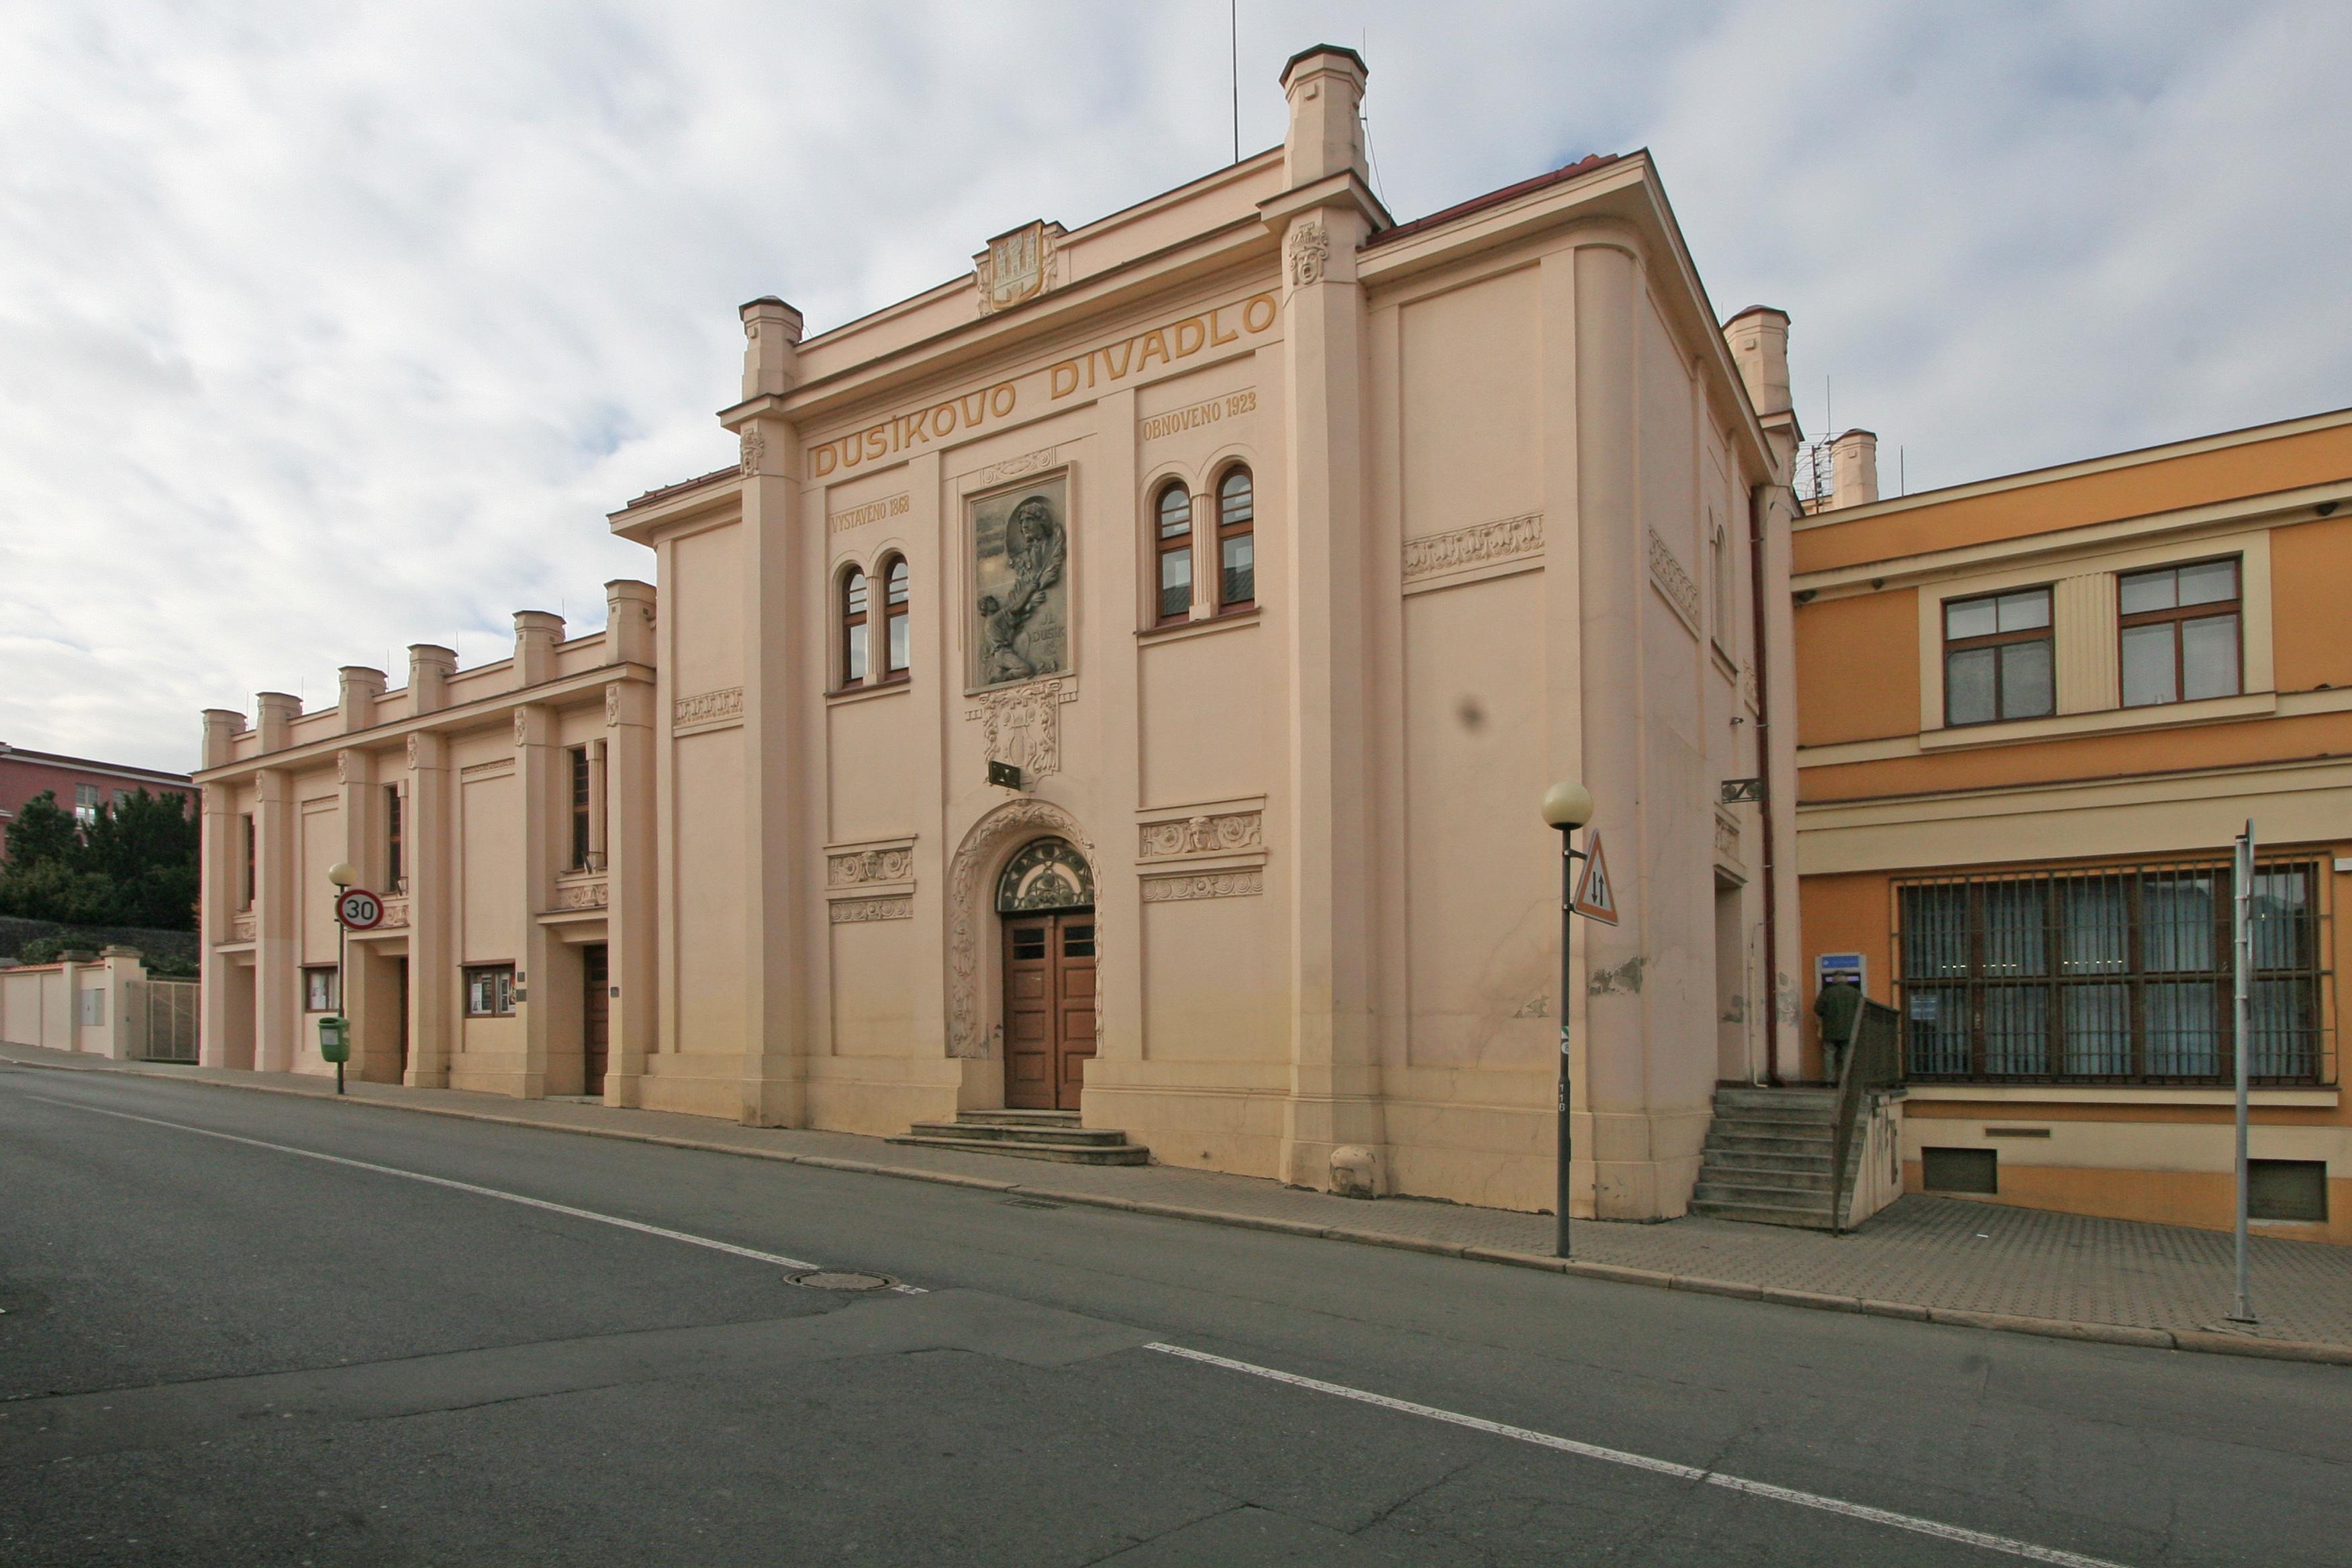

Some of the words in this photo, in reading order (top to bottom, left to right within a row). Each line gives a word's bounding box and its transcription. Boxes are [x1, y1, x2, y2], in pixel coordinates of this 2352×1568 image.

[1050, 293, 1276, 401] DIVADLO
[1143, 402, 1221, 441] OBNOVENO
[1226, 391, 1257, 418] 1923
[832, 503, 886, 533] VYSTAVENO
[889, 495, 910, 516] 1868
[346, 899, 373, 920] 30
